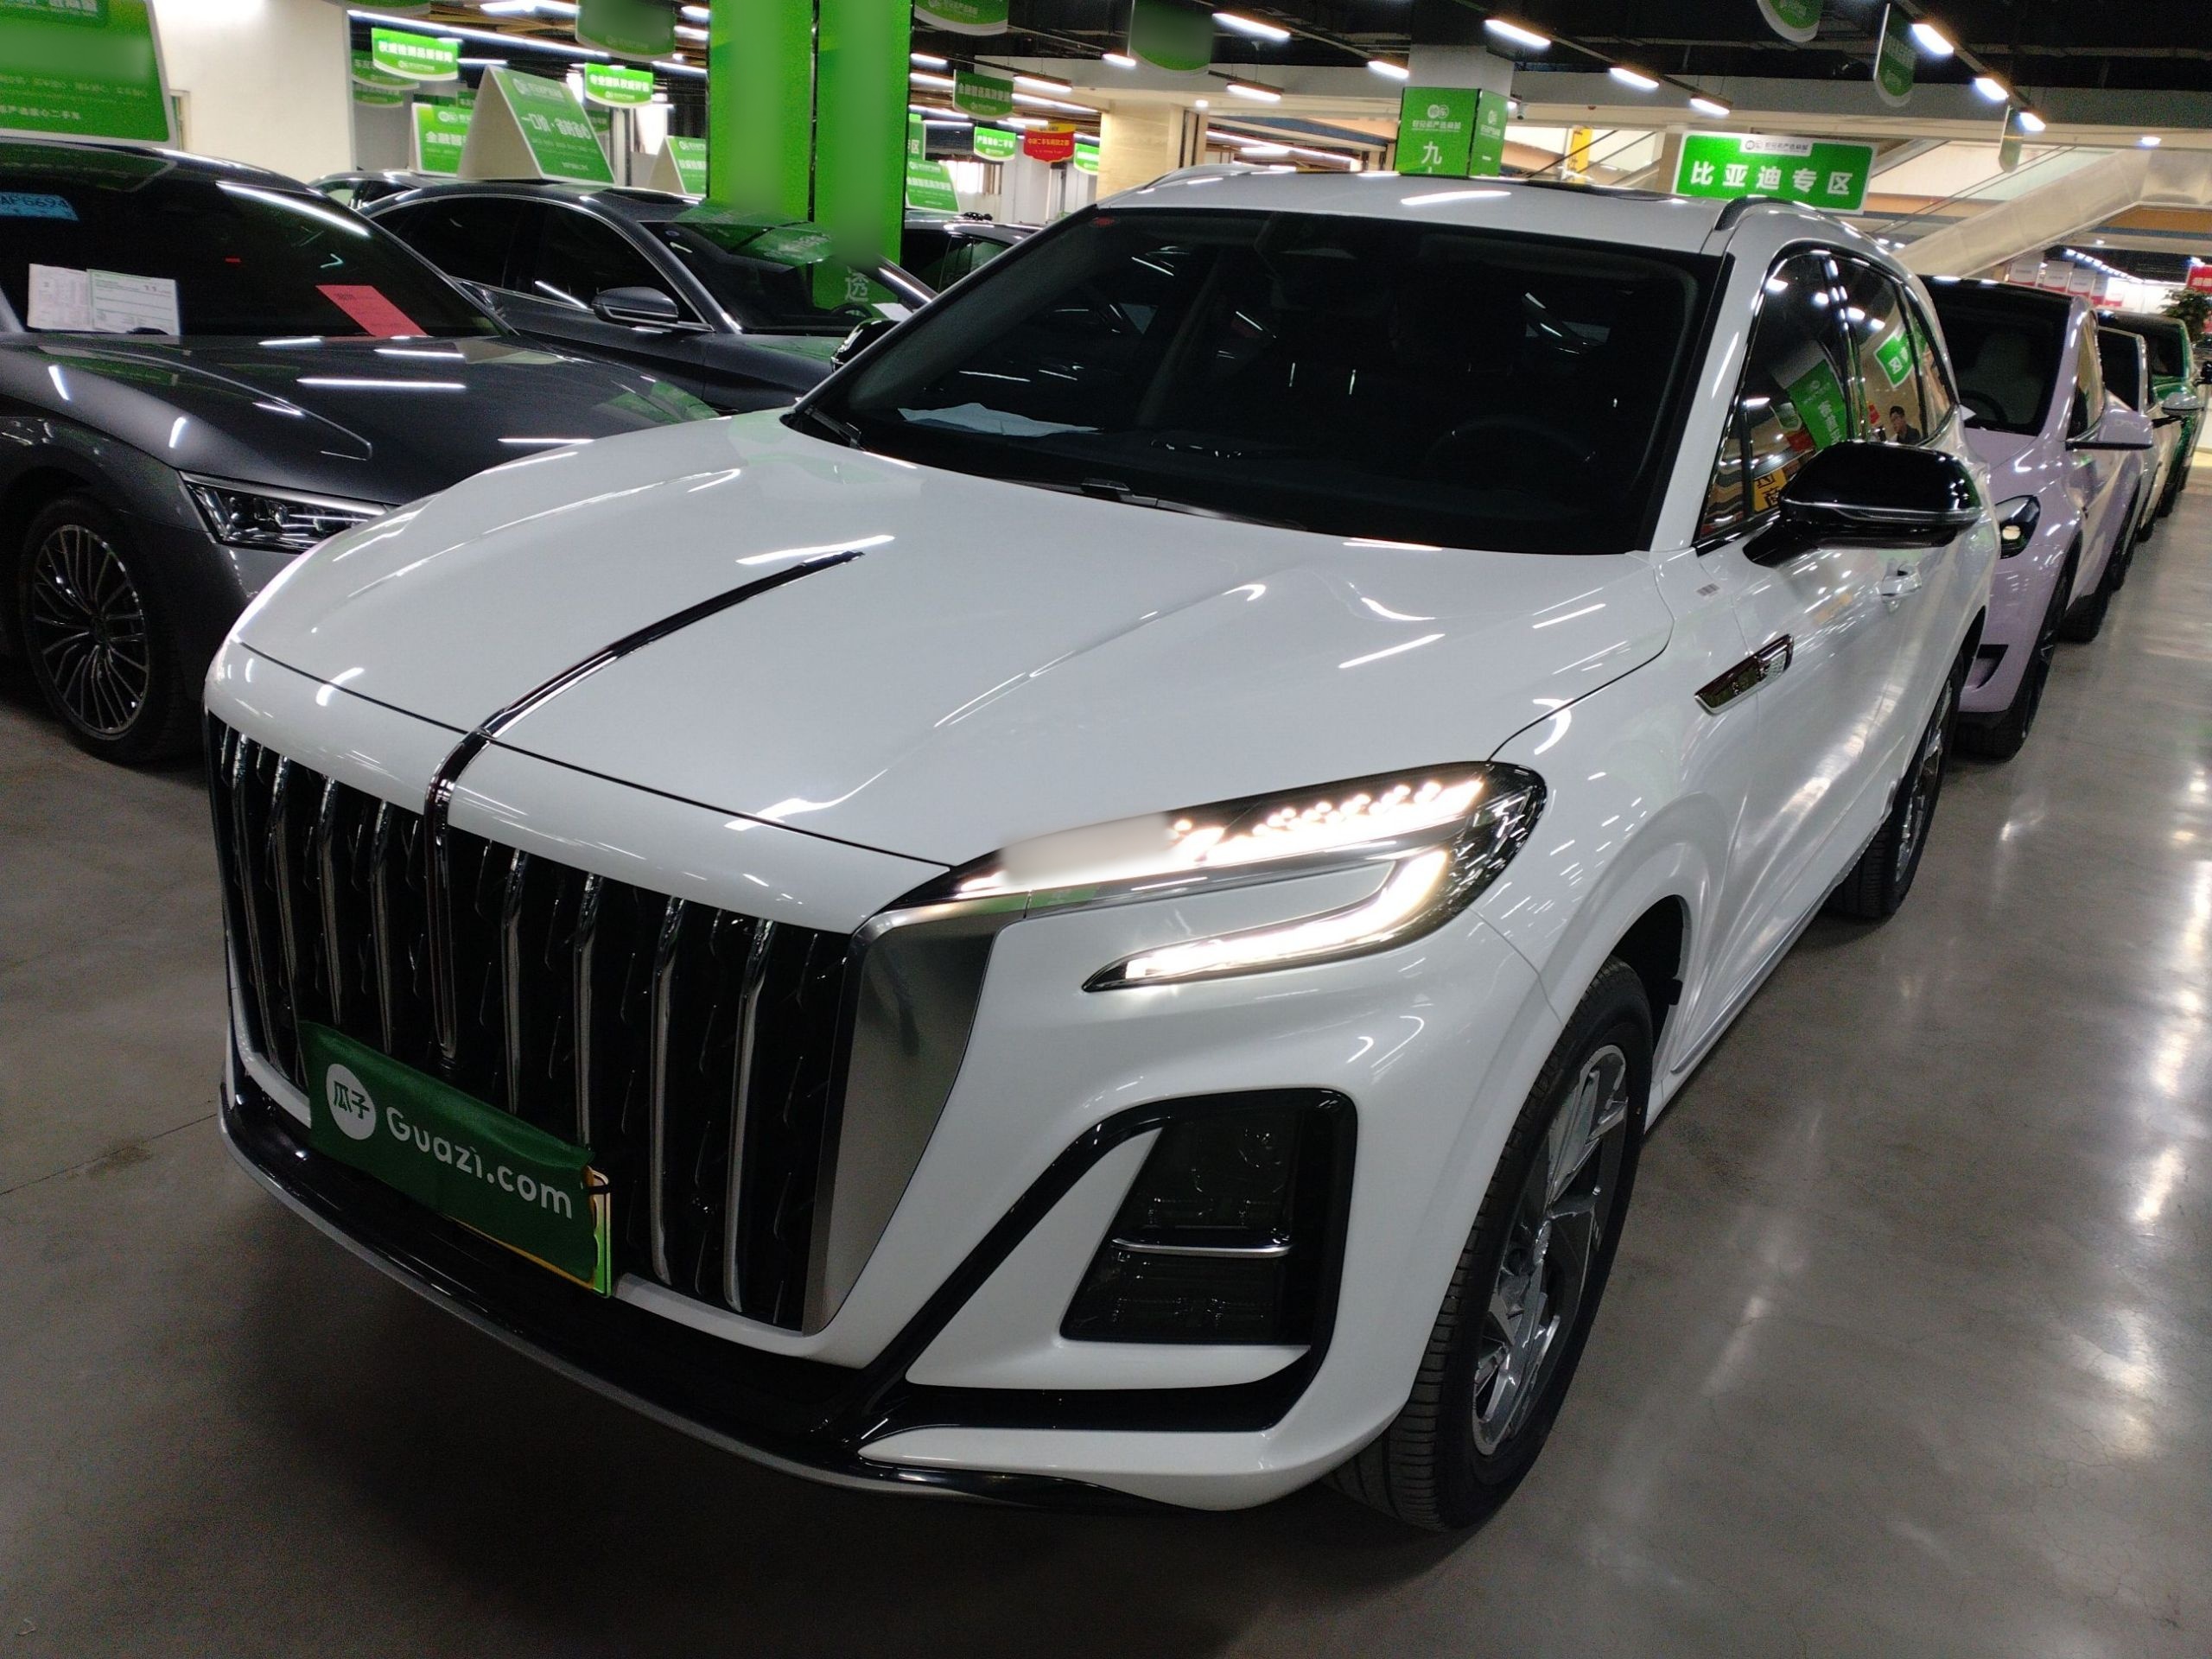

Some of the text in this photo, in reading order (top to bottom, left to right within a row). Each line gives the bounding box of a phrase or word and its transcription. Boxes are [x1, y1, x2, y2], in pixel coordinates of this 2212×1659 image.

[1690, 161, 1853, 195] 比亚迪专区
[334, 1082, 370, 1119] 瓜子
